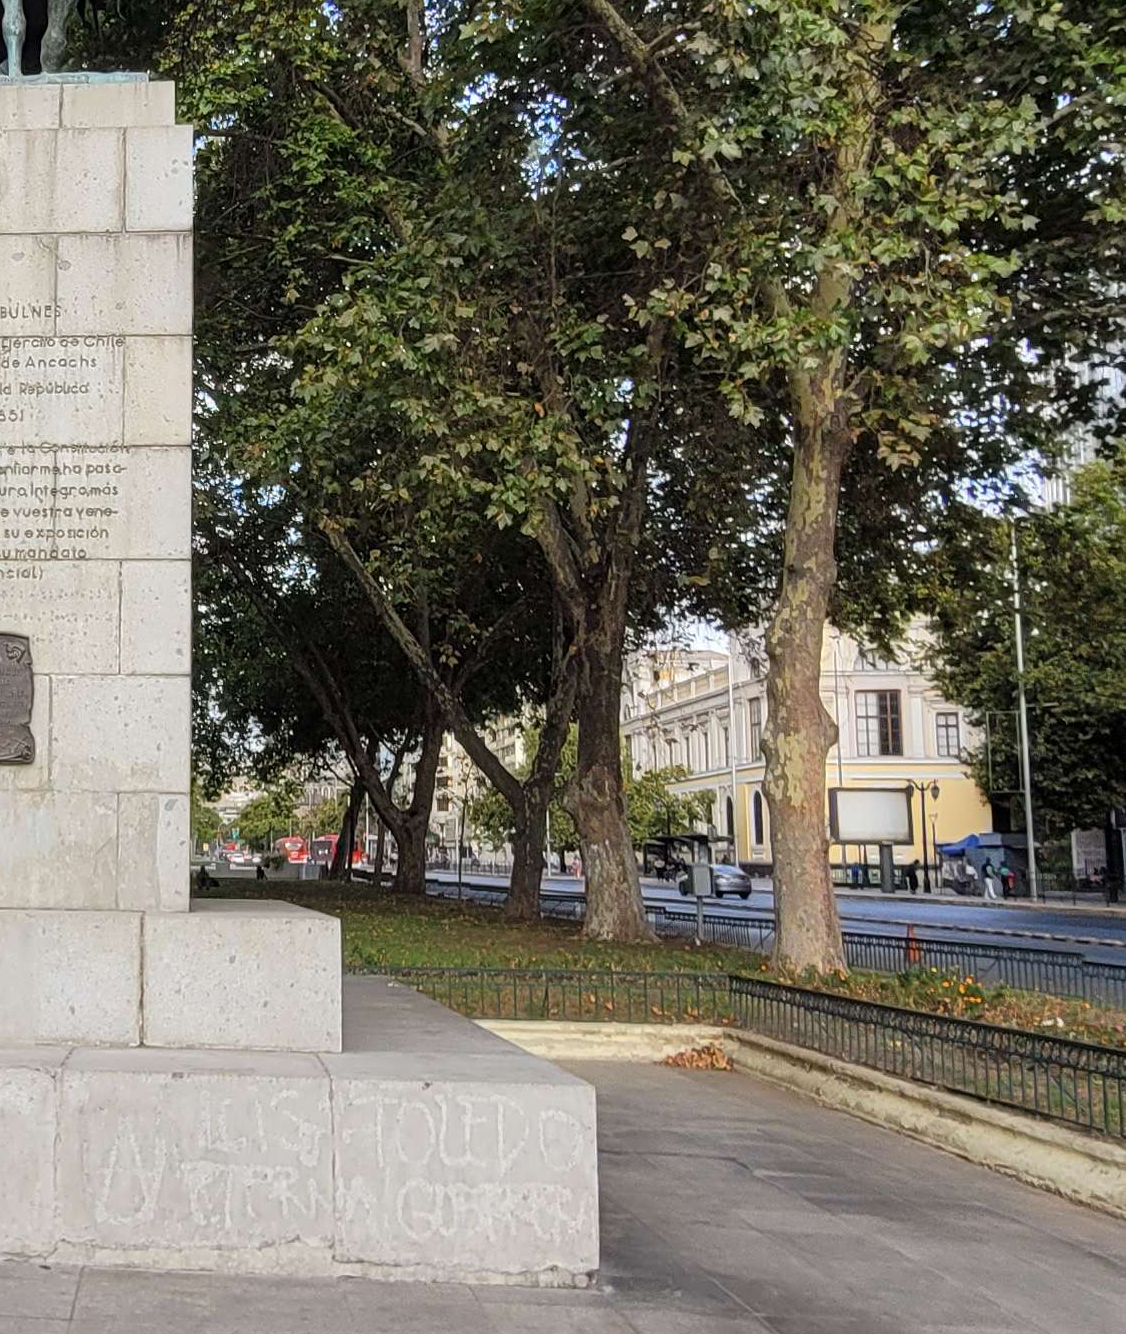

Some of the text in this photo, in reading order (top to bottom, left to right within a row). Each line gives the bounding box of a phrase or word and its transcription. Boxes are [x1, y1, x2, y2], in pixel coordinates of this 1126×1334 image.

[0, 303, 62, 319] BULNES
[83, 335, 126, 348] Chile
[0, 356, 20, 369] de
[25, 355, 98, 368] Ancachs
[0, 381, 12, 395] la
[62, 462, 83, 475] ha
[13, 506, 74, 518] vuestra
[4, 528, 20, 539] su
[24, 525, 110, 541] exposición
[14, 546, 87, 559] mandato
